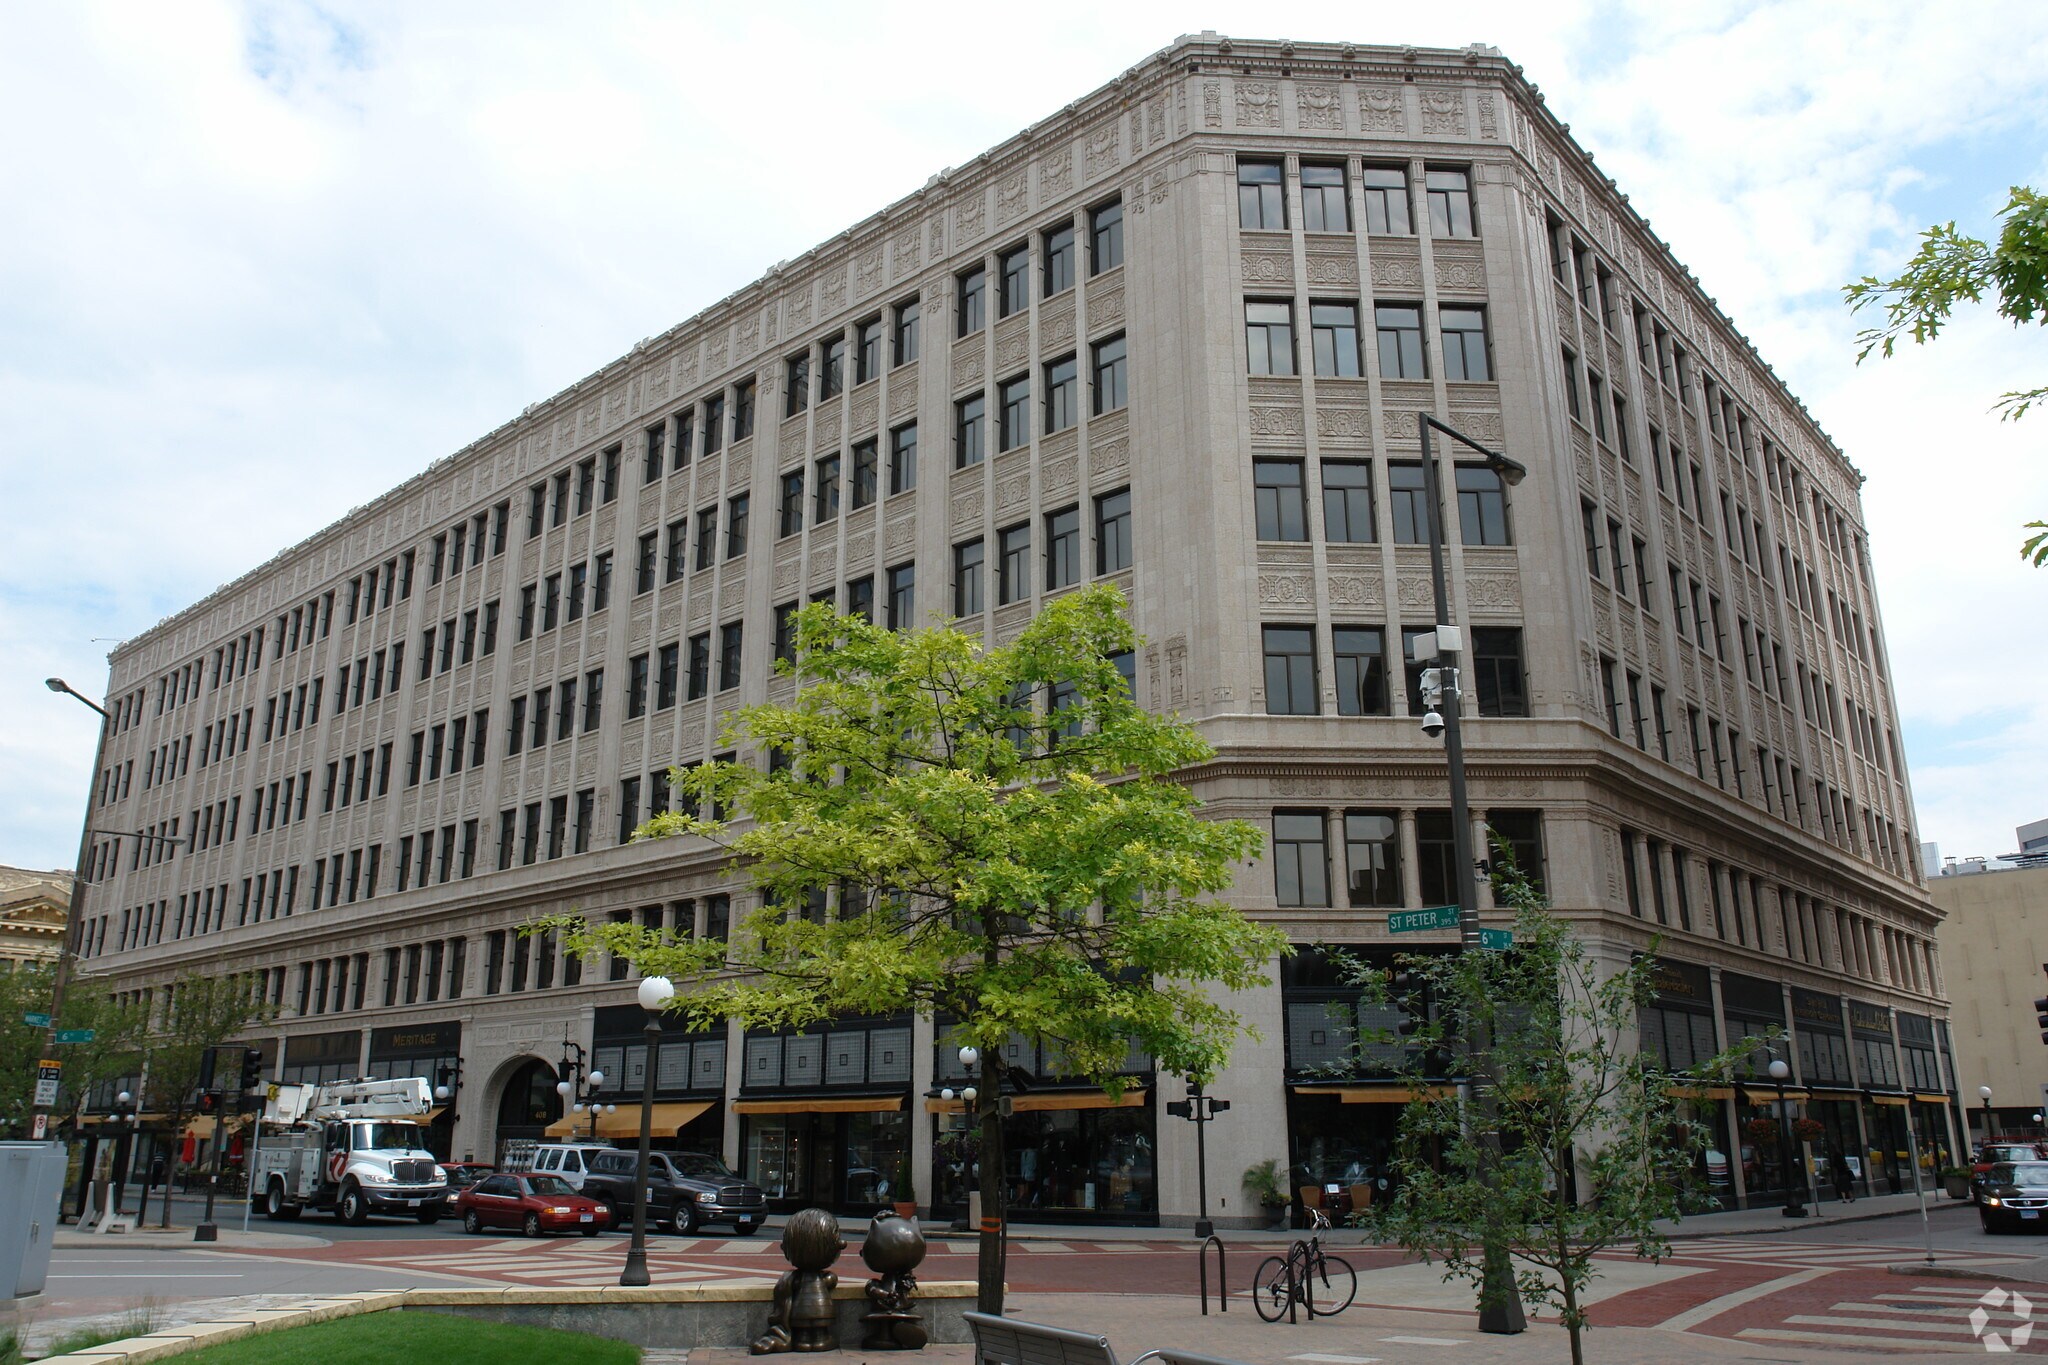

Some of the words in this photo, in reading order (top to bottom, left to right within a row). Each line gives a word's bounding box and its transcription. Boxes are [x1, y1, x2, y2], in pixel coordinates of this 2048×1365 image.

[1390, 916, 1402, 929] ST
[1405, 912, 1437, 928] PETER
[1440, 918, 1452, 926] 395
[393, 1033, 436, 1046] MERITAGE
